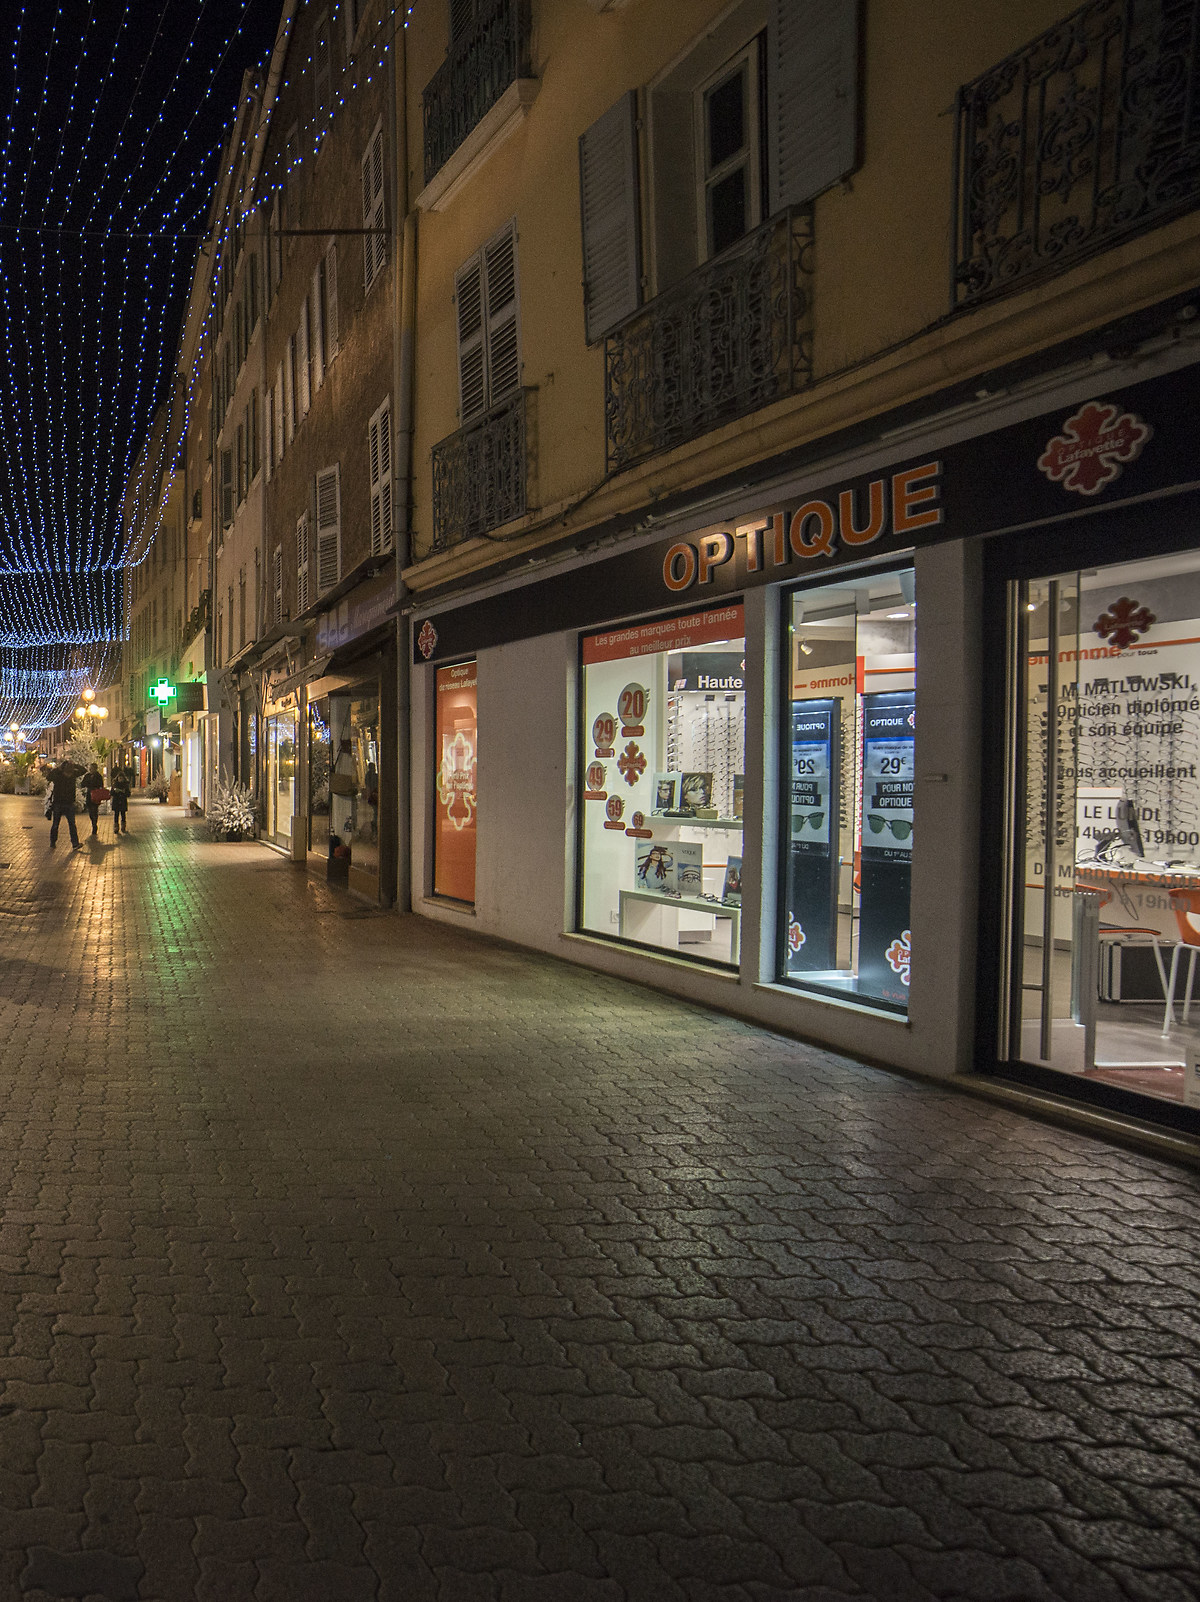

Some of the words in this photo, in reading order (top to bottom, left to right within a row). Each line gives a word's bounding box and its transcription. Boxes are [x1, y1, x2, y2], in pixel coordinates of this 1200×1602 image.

[1058, 438, 1125, 465] Lafayette
[663, 461, 942, 591] OPTIQUE
[595, 636, 607, 646] Les
[609, 630, 639, 646] grandes
[640, 623, 676, 638] marques
[678, 617, 701, 630] toute
[703, 609, 738, 625] l'année
[629, 646, 640, 655] au
[641, 639, 673, 653] meilleur
[675, 634, 692, 649] prix
[698, 675, 743, 689] Haute
[622, 690, 645, 718] 20
[1057, 702, 1121, 720] Opticien
[1127, 696, 1200, 717] diplômé
[595, 719, 614, 743] 29
[870, 718, 904, 727] OPTIQUE
[1088, 725, 1117, 737] son
[1123, 720, 1183, 738] équipe
[1058, 766, 1092, 778] ous
[1099, 763, 1196, 778] accueillent
[882, 784, 901, 793] POUR
[880, 797, 912, 807] OPTIQUE
[1084, 806, 1102, 819] LE
[1145, 829, 1199, 845] 19h00
